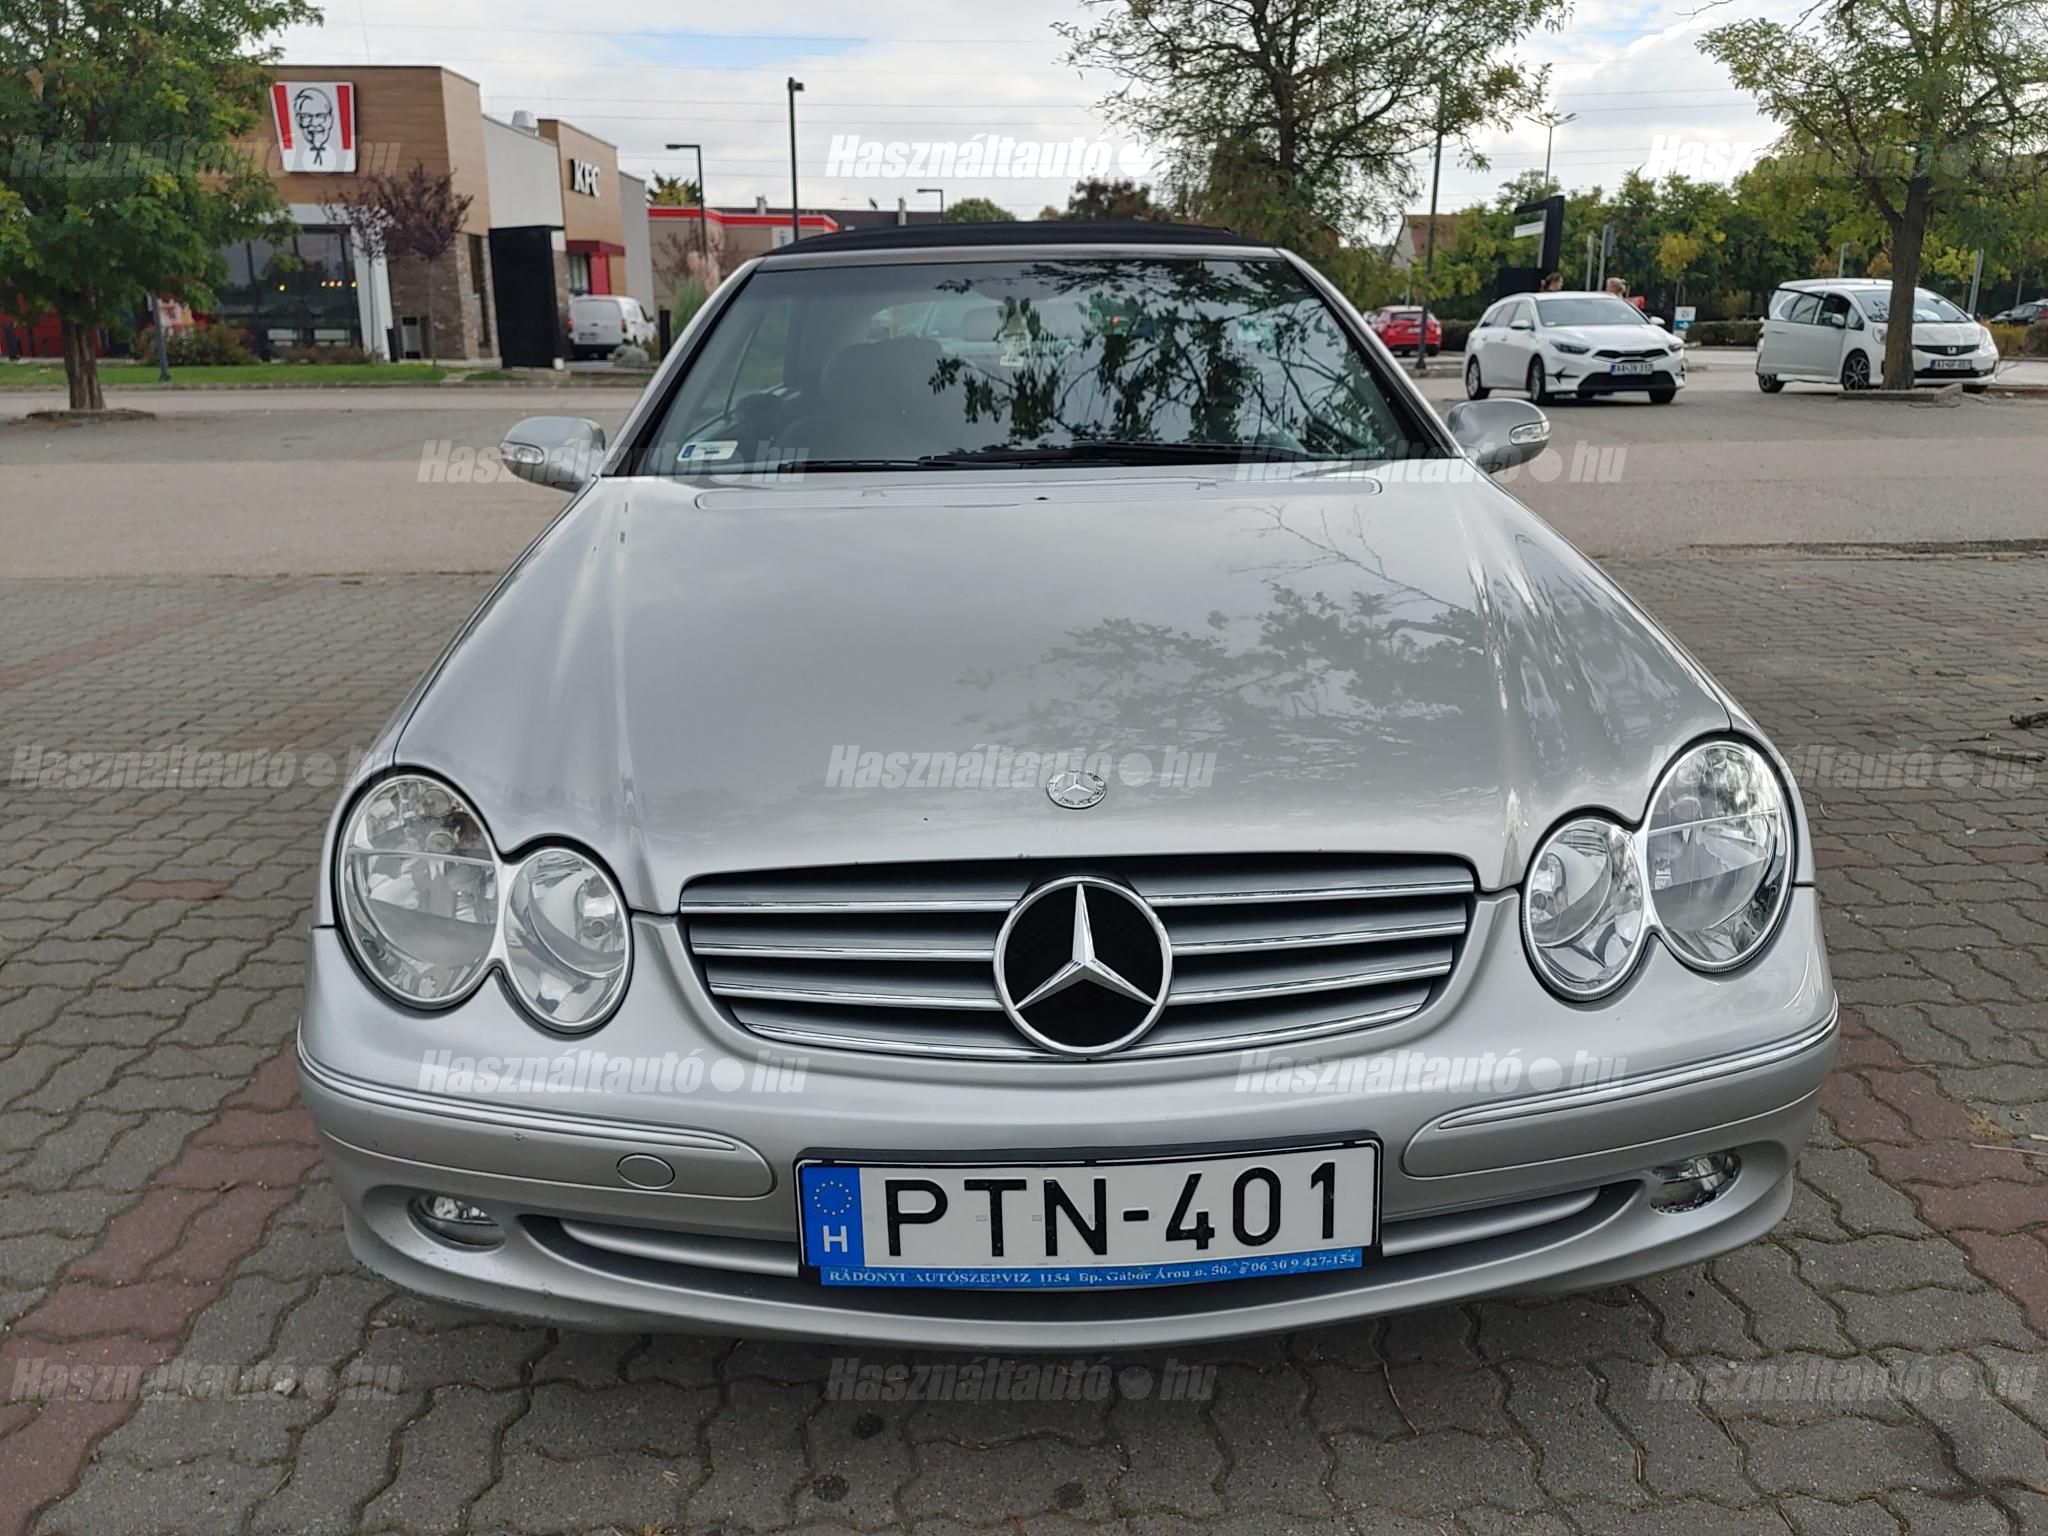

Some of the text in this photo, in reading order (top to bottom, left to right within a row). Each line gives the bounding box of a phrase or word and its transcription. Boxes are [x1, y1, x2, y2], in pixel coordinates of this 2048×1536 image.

[572, 158, 601, 198] KFC
[884, 1160, 1337, 1258] PTN-401
[823, 1224, 848, 1253] H
[1040, 1273, 1070, 1283] 1154
[1078, 1272, 1102, 1284] Bp.
[1106, 1269, 1152, 1282] Gábor
[1250, 1261, 1268, 1272] 06
[1271, 1260, 1288, 1271] 30
[1290, 1258, 1300, 1269] 9
[1302, 1253, 1356, 1267] 427-154
